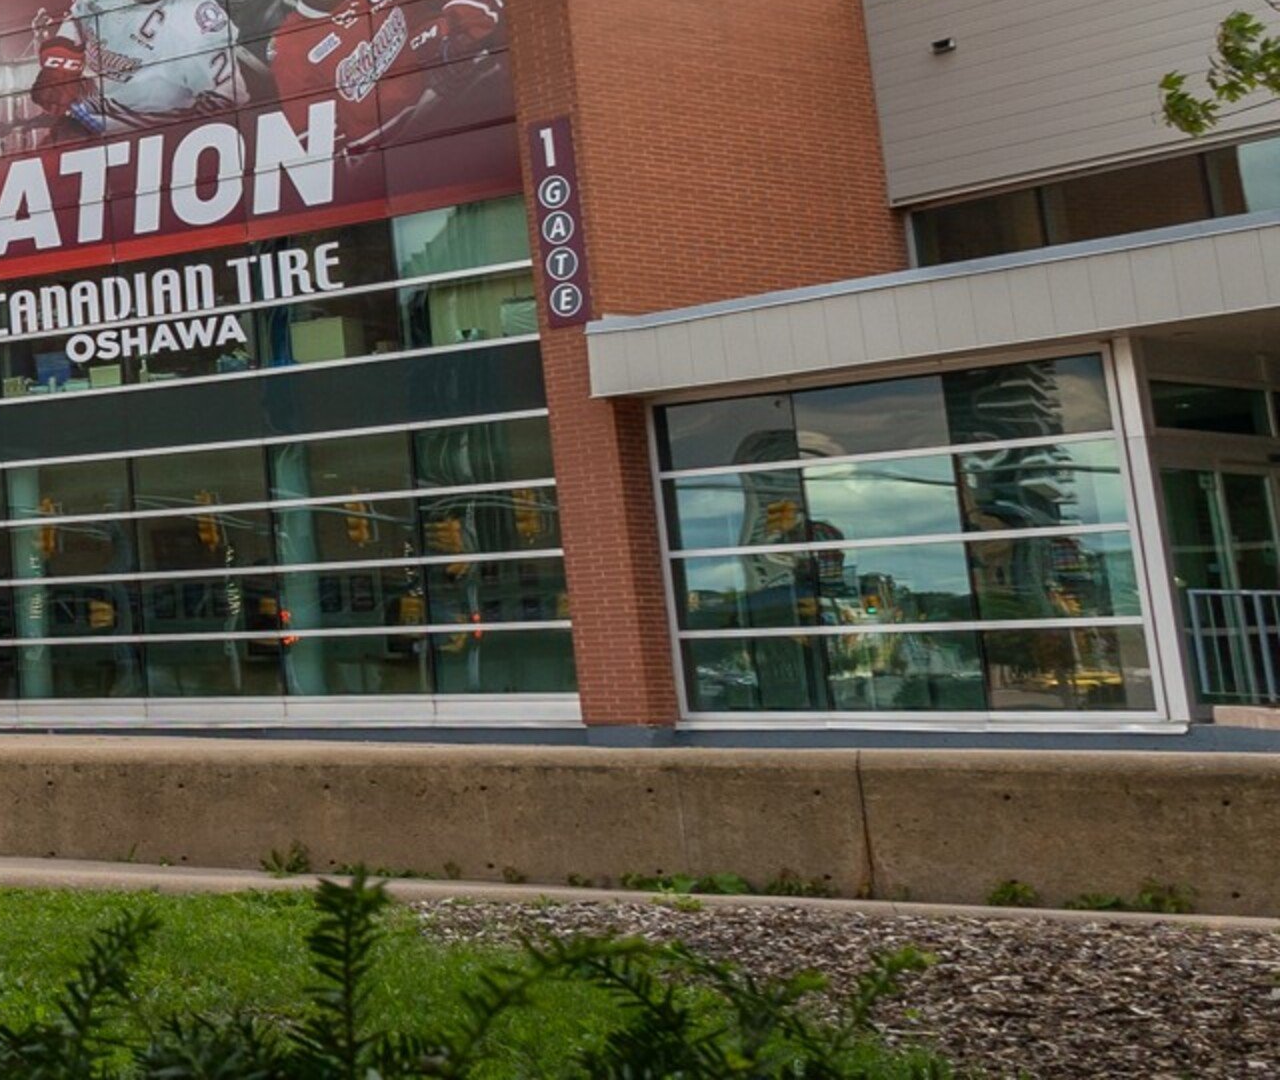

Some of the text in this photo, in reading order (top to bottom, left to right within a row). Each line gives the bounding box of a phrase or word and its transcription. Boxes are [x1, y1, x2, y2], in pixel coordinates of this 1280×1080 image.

[539, 127, 573, 311] 1 GATE
[226, 241, 345, 306] TIRE
[65, 313, 247, 364] OSHAWA
